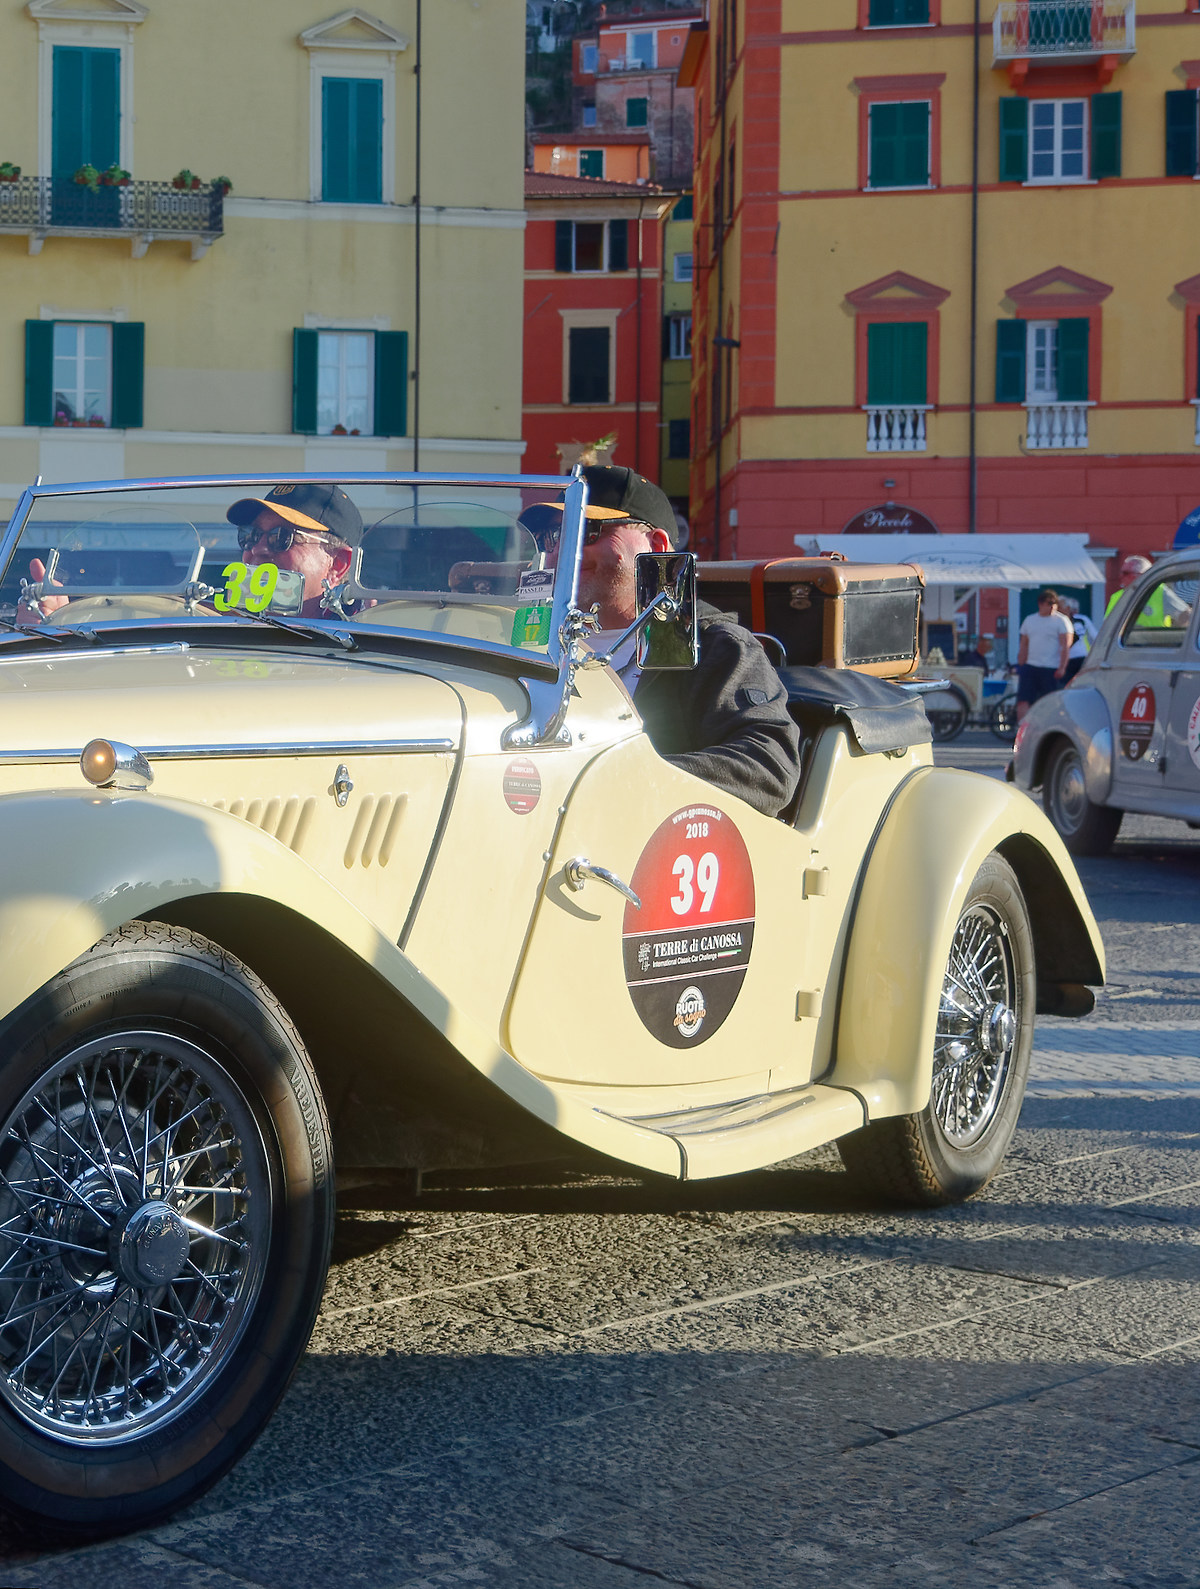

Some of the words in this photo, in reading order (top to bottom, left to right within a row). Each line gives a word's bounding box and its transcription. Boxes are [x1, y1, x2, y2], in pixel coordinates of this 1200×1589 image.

[864, 511, 913, 527] Piccolo
[214, 562, 278, 613] 39
[525, 625, 541, 642] 17
[1131, 697, 1147, 718] 40
[685, 822, 709, 839] 2018
[670, 852, 719, 915] 39
[653, 939, 688, 958] TERRE
[689, 938, 699, 953] di
[700, 932, 742, 951] CANOSSA
[676, 1000, 704, 1015] RUOTE
